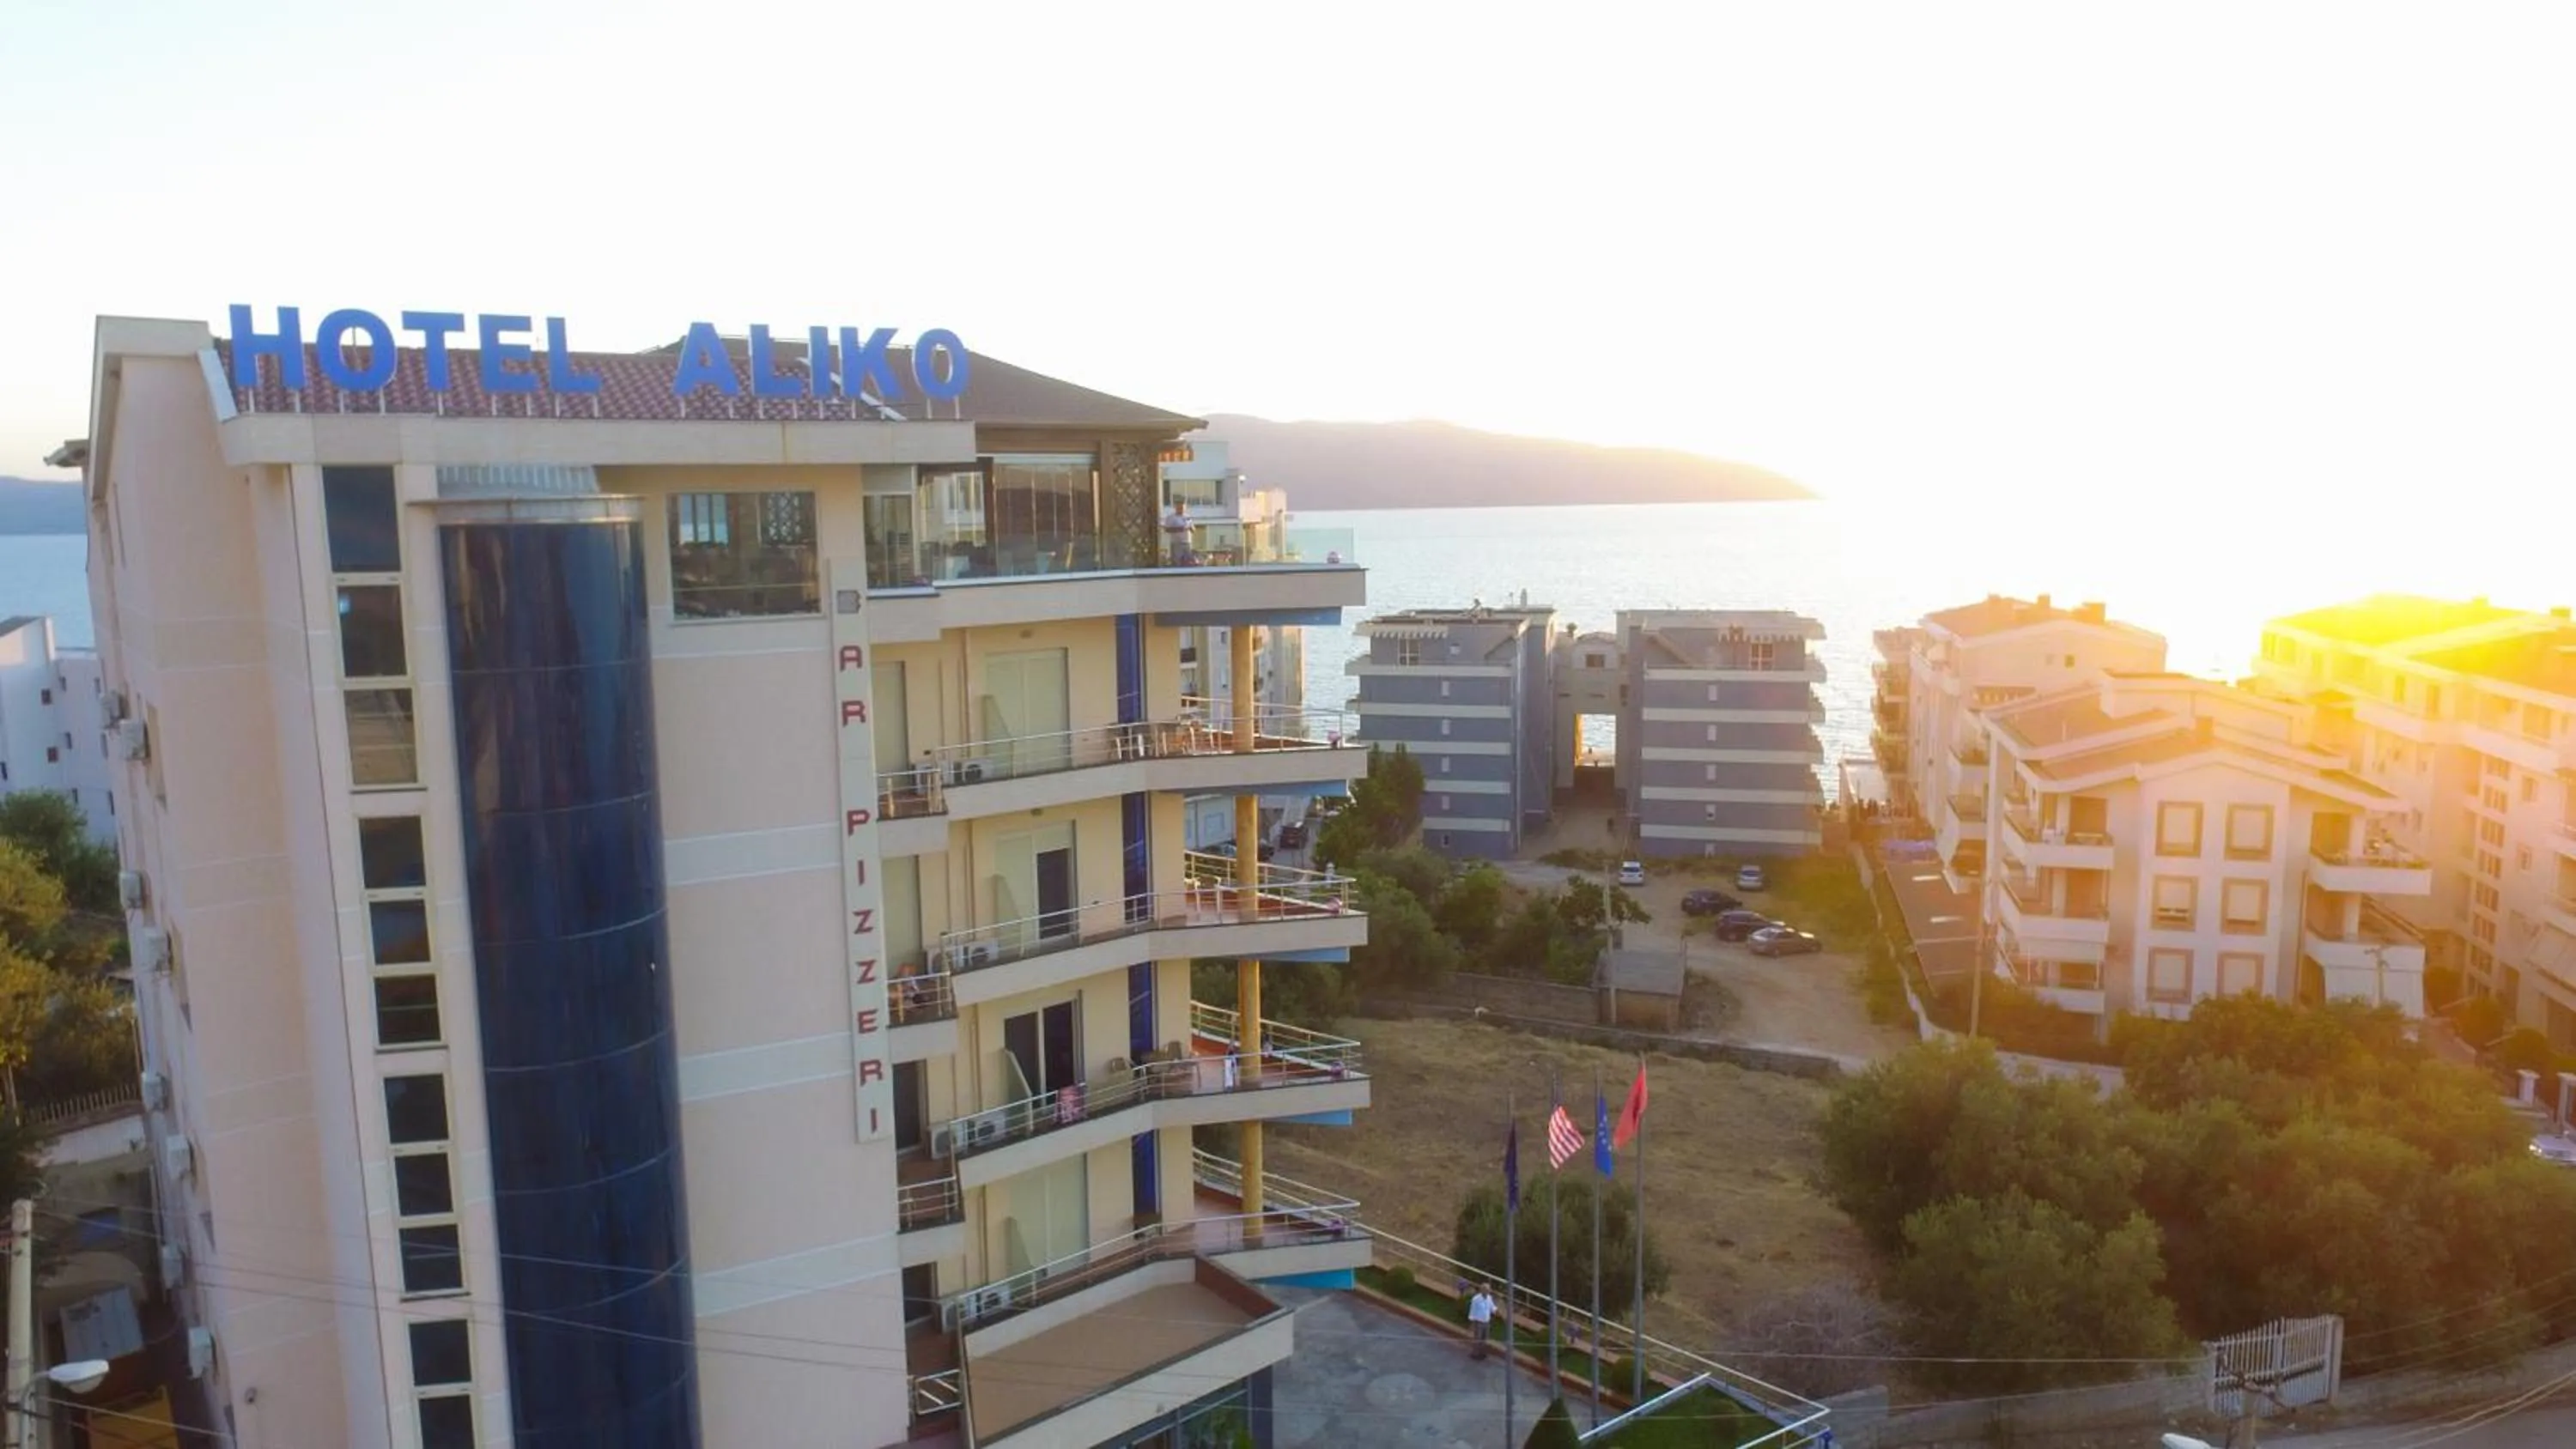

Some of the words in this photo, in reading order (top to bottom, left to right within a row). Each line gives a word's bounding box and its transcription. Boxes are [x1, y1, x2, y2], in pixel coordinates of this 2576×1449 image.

[228, 304, 601, 393] HOTEL
[674, 321, 970, 400] ALIKO
[836, 590, 866, 727] BAR
[847, 809, 883, 1133] PIZZERI
